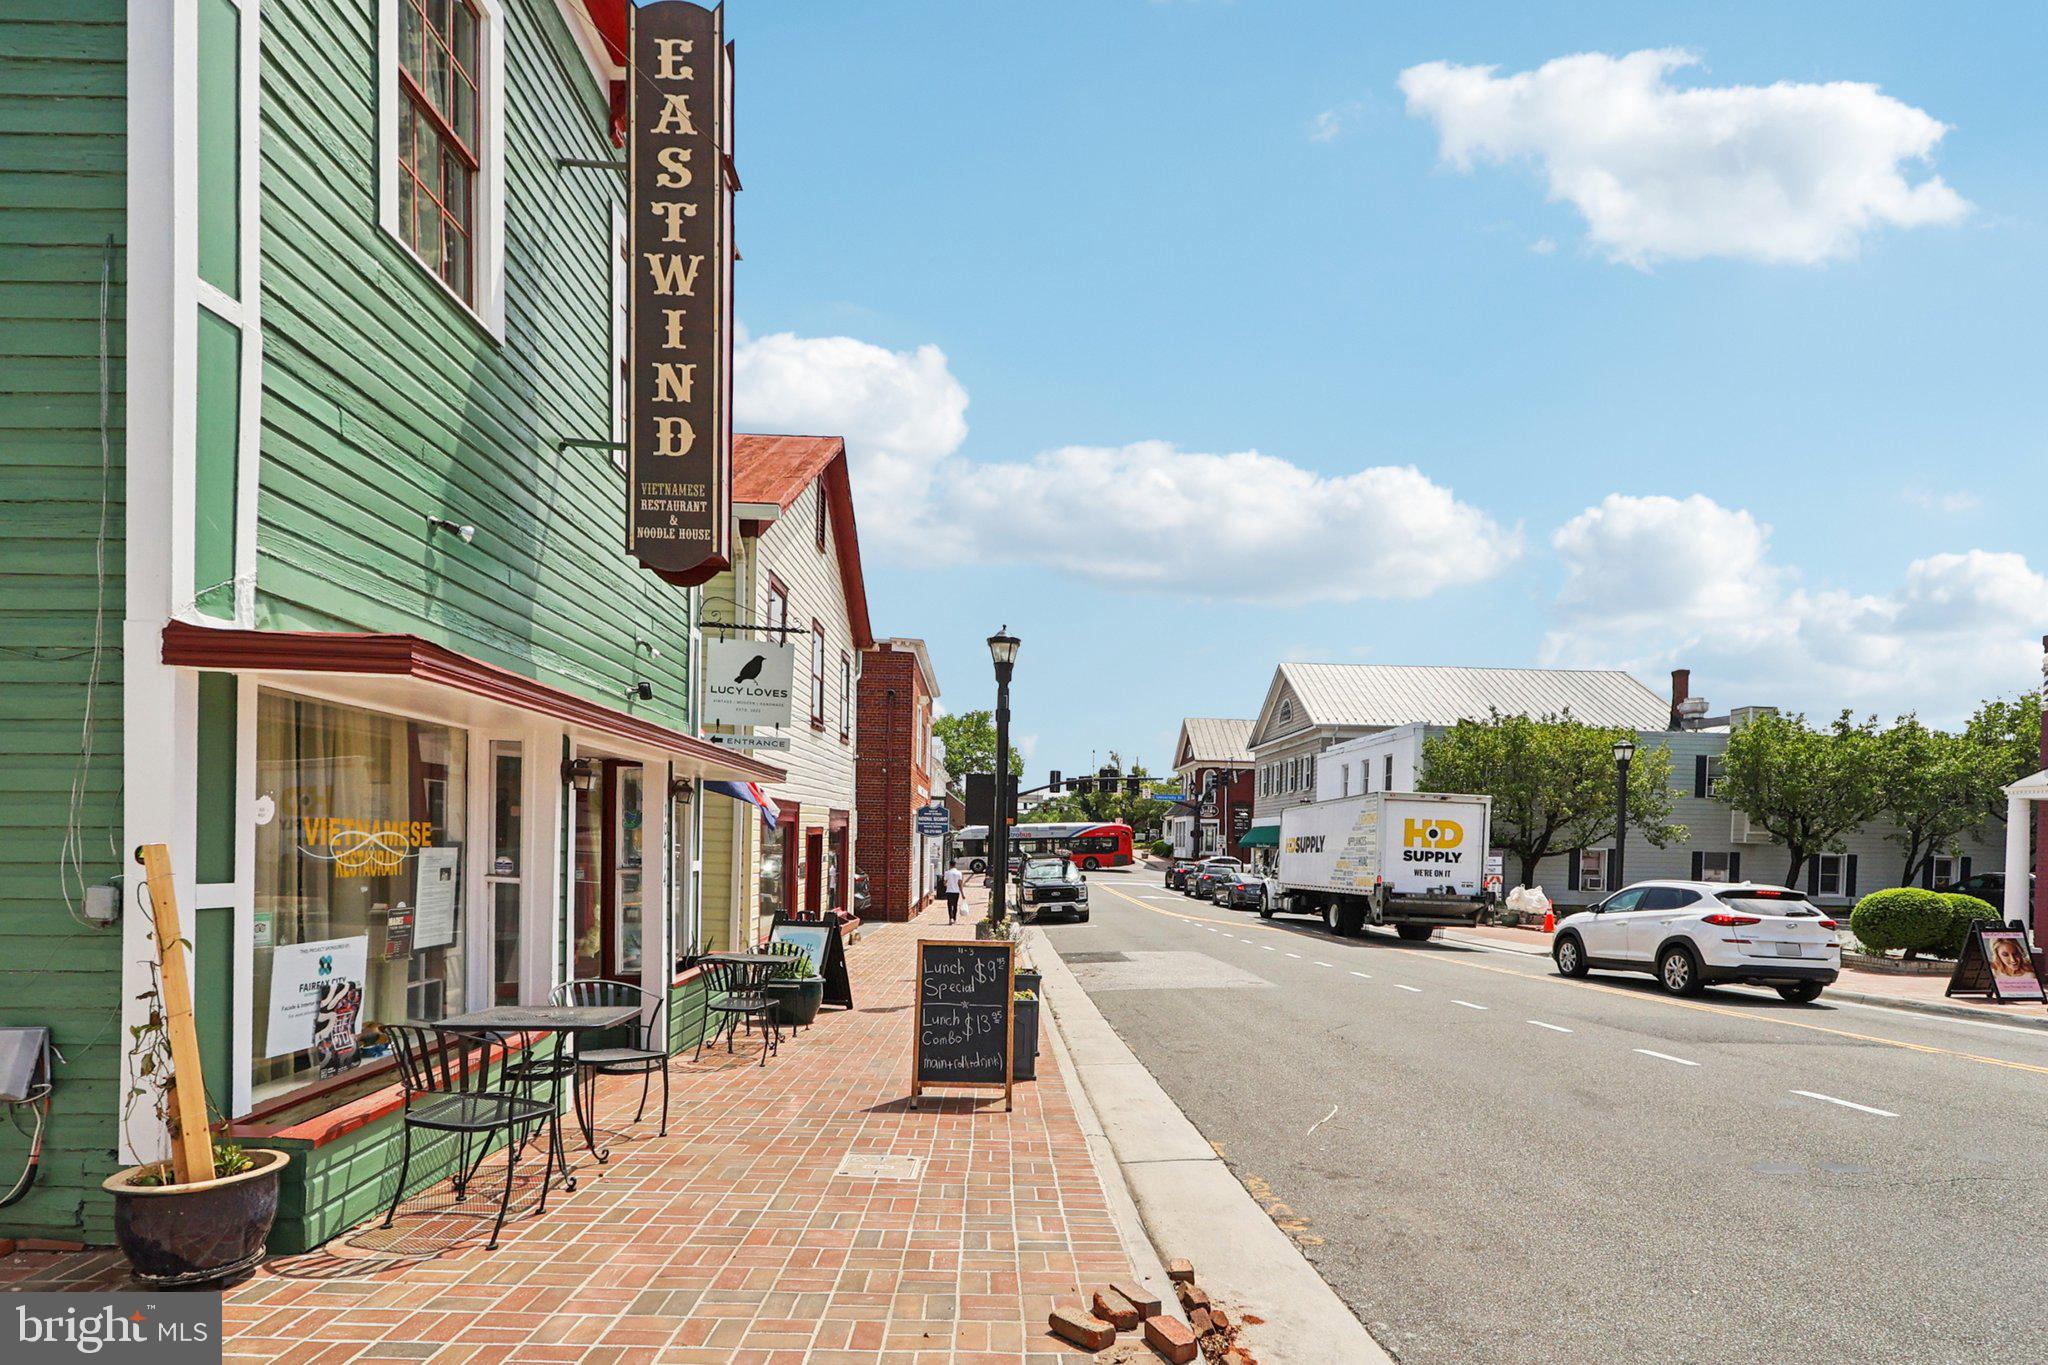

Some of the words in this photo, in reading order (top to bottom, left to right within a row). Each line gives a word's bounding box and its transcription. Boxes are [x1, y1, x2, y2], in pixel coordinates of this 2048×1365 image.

[641, 482, 706, 497] VIETNAMESE
[641, 499, 708, 513] RESTAURANT
[669, 514, 678, 526] &
[637, 526, 675, 539] NOODLE
[678, 528, 711, 541] HOUSE
[710, 685, 744, 695] LUCY
[746, 688, 788, 698] LOVES
[727, 738, 785, 748] ENTRANCE
[303, 816, 433, 847] VIETNAMESE
[1295, 835, 1326, 853] SUPPLY
[335, 849, 404, 878] RESTAURANT
[1403, 850, 1462, 863] SUPPLY
[1434, 869, 1443, 877] ON
[1444, 870, 1451, 878] IT
[923, 958, 965, 975] Lunch
[924, 975, 975, 999] Special
[922, 1008, 960, 1027] Lunch
[922, 1030, 963, 1046] Combo
